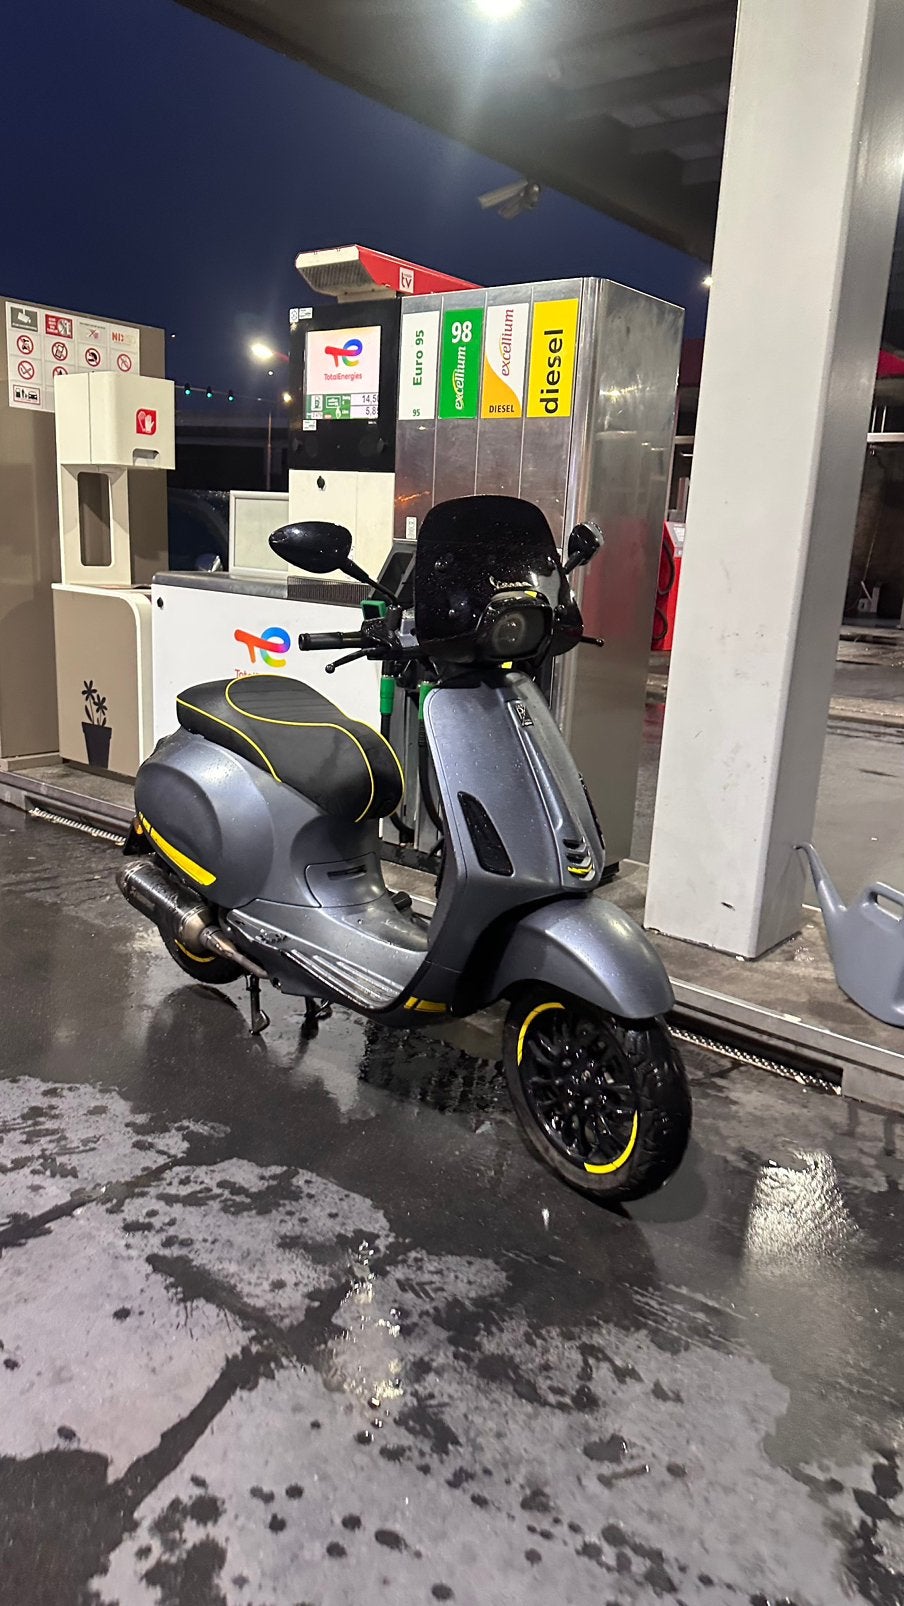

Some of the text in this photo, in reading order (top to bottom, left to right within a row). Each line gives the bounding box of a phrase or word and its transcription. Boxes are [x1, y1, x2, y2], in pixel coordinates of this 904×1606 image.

[451, 320, 473, 343] 98
[500, 309, 514, 377] excellium
[323, 371, 363, 382] TotalEnergies
[412, 329, 425, 386] Euro 95
[540, 329, 564, 414] diesel
[454, 346, 467, 410] excellium
[412, 408, 421, 417] 95
[488, 404, 515, 413] DIESEL
